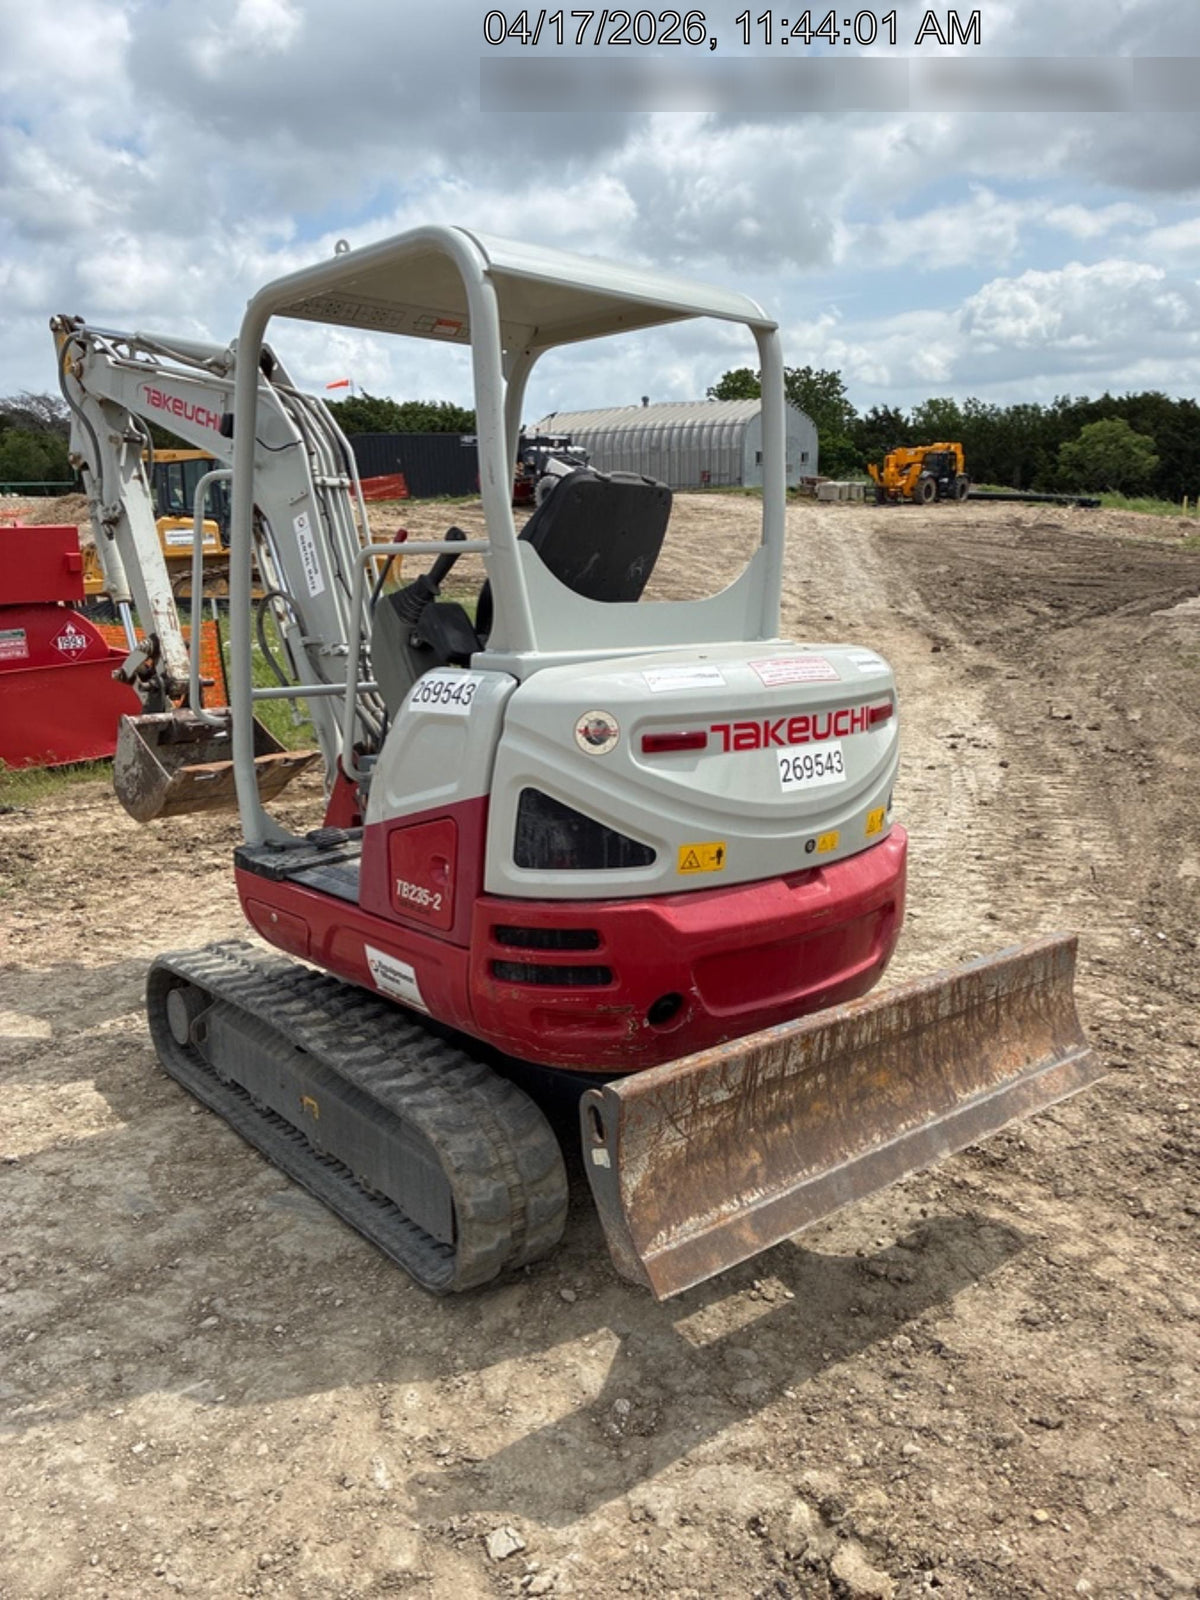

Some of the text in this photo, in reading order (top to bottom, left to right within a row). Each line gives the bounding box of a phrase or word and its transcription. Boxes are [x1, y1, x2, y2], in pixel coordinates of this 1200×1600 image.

[411, 680, 477, 706] 269543
[710, 706, 869, 752] TAKEUCHI
[780, 750, 844, 783] 269543
[396, 879, 442, 911] TB235-2
